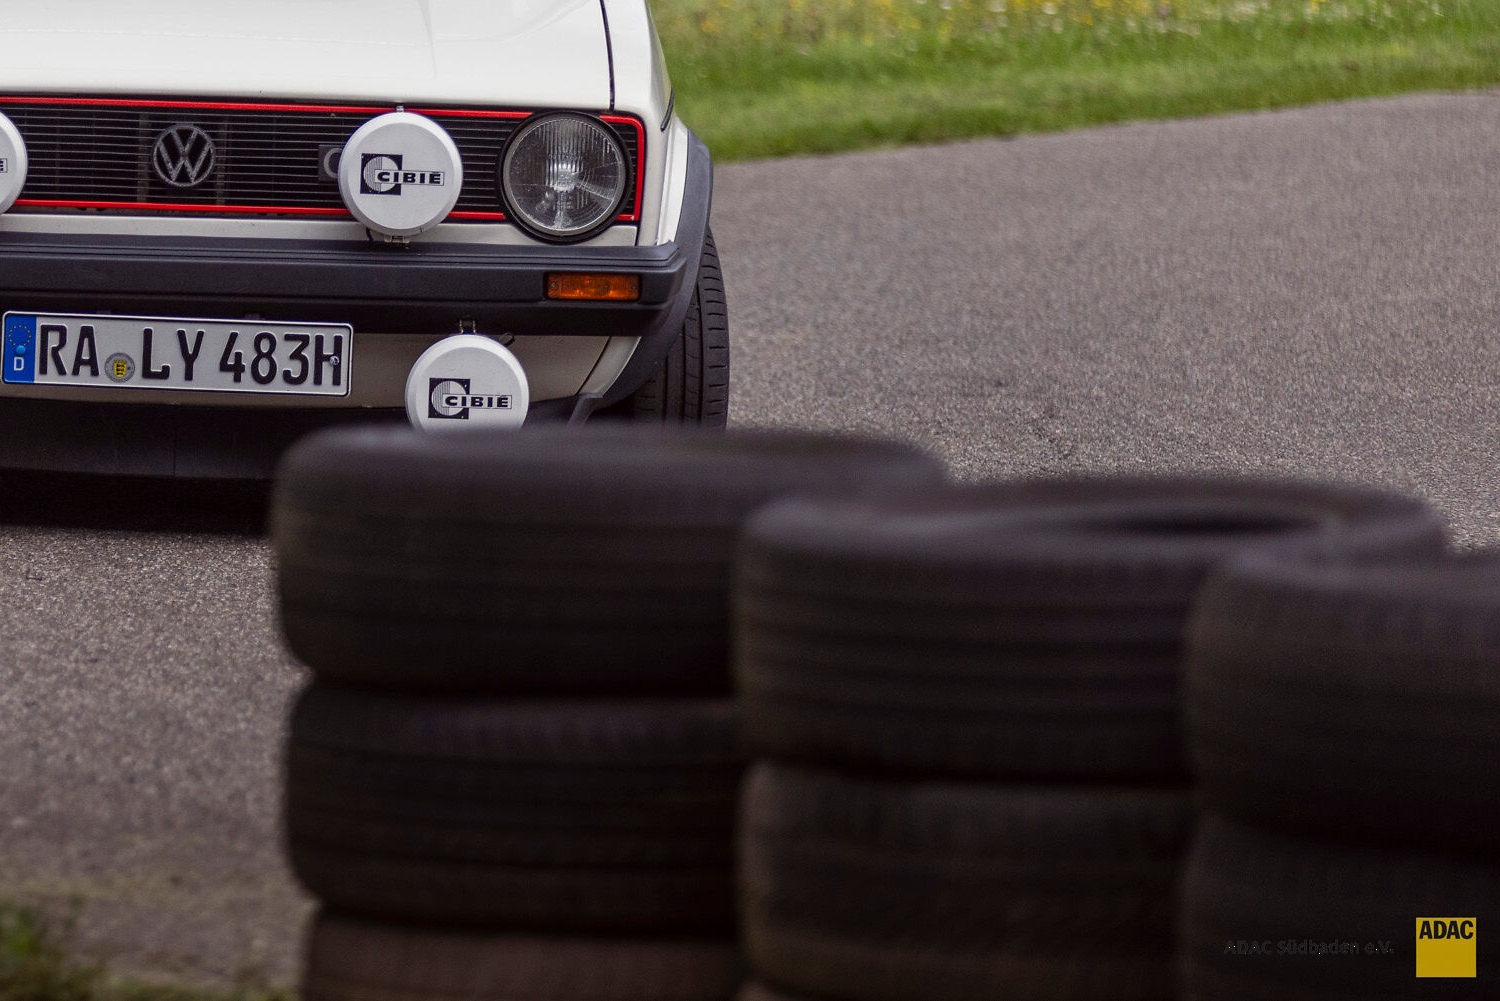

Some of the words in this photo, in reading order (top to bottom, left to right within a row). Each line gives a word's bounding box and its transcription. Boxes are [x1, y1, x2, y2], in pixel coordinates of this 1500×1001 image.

[13, 356, 25, 371] D
[39, 324, 100, 377] RA
[142, 327, 205, 381] LY
[219, 331, 343, 386] 483H
